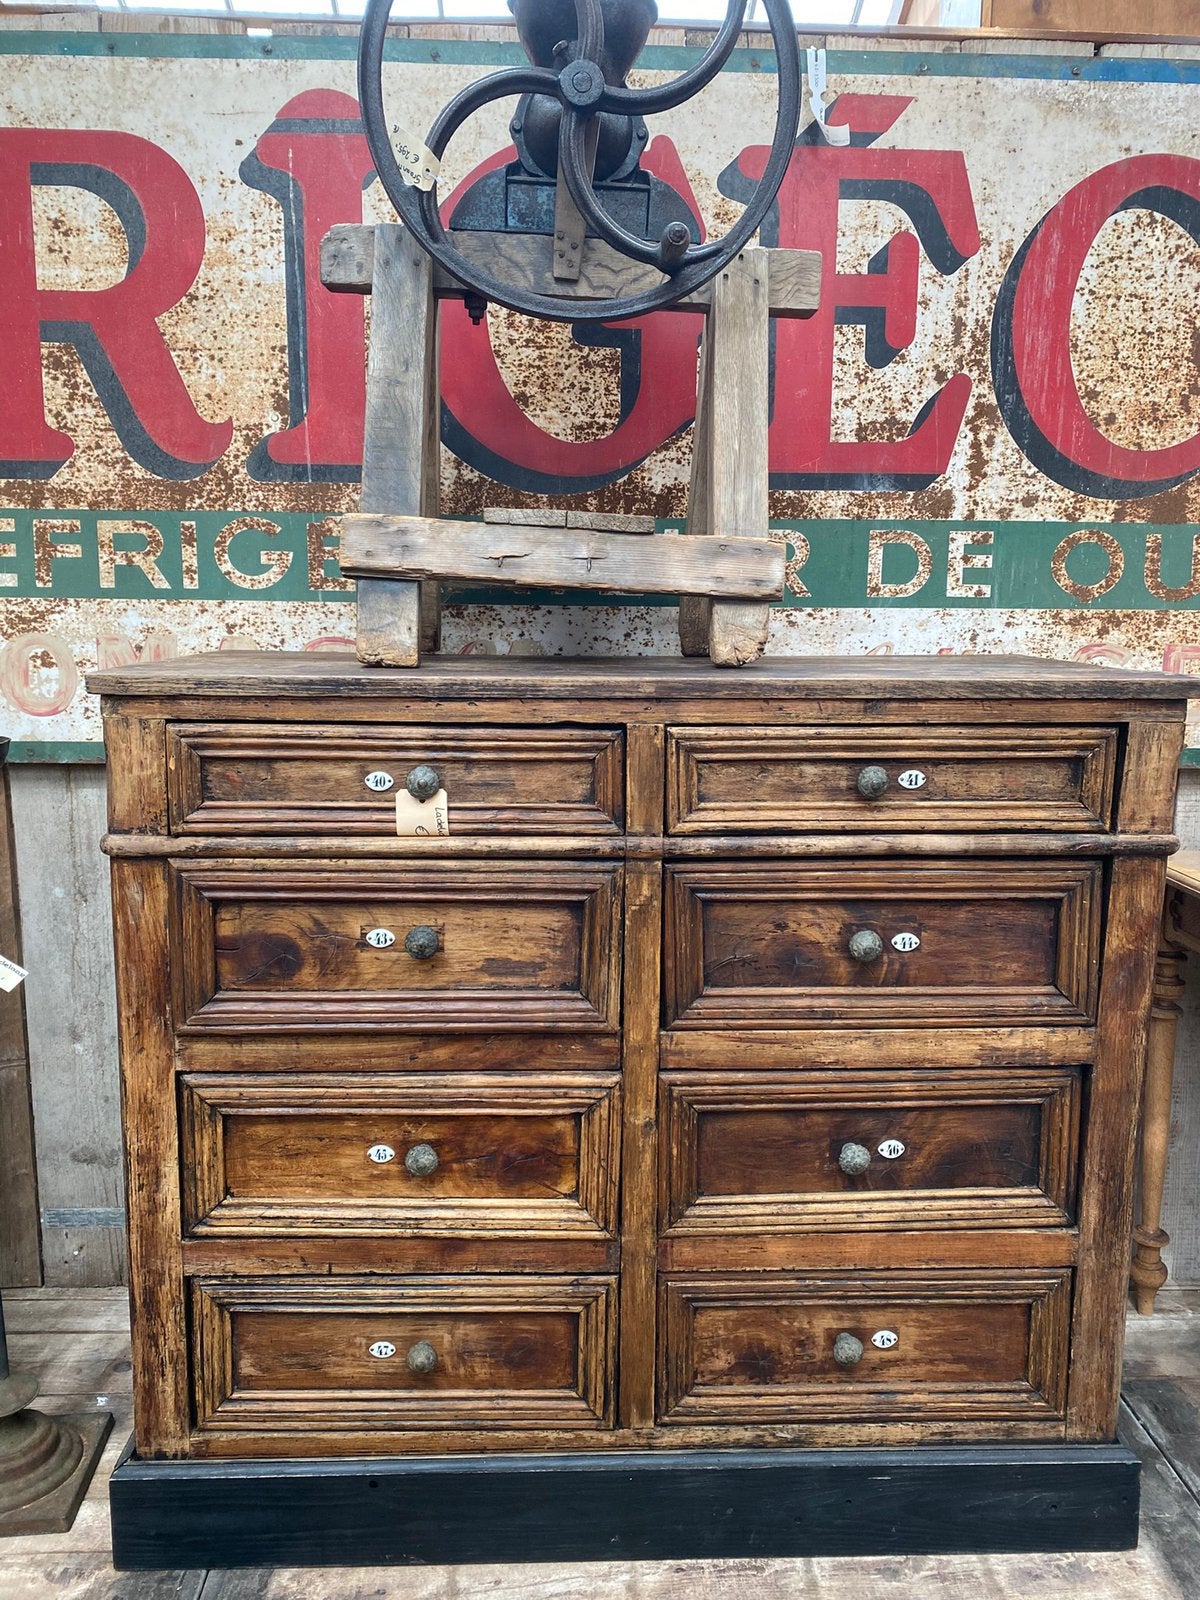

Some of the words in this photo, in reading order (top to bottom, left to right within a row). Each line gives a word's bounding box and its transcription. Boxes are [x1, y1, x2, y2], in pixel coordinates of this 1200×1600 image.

[867, 529, 995, 598] DE
[1051, 528, 1200, 603] OU
[372, 775, 386, 787] 40
[906, 773, 919, 786] 41
[374, 932, 388, 945] 43
[900, 937, 913, 949] 44
[375, 1148, 387, 1161] 45
[886, 1144, 899, 1156] 46
[878, 1335, 892, 1346] 48
[376, 1345, 389, 1356] 47
